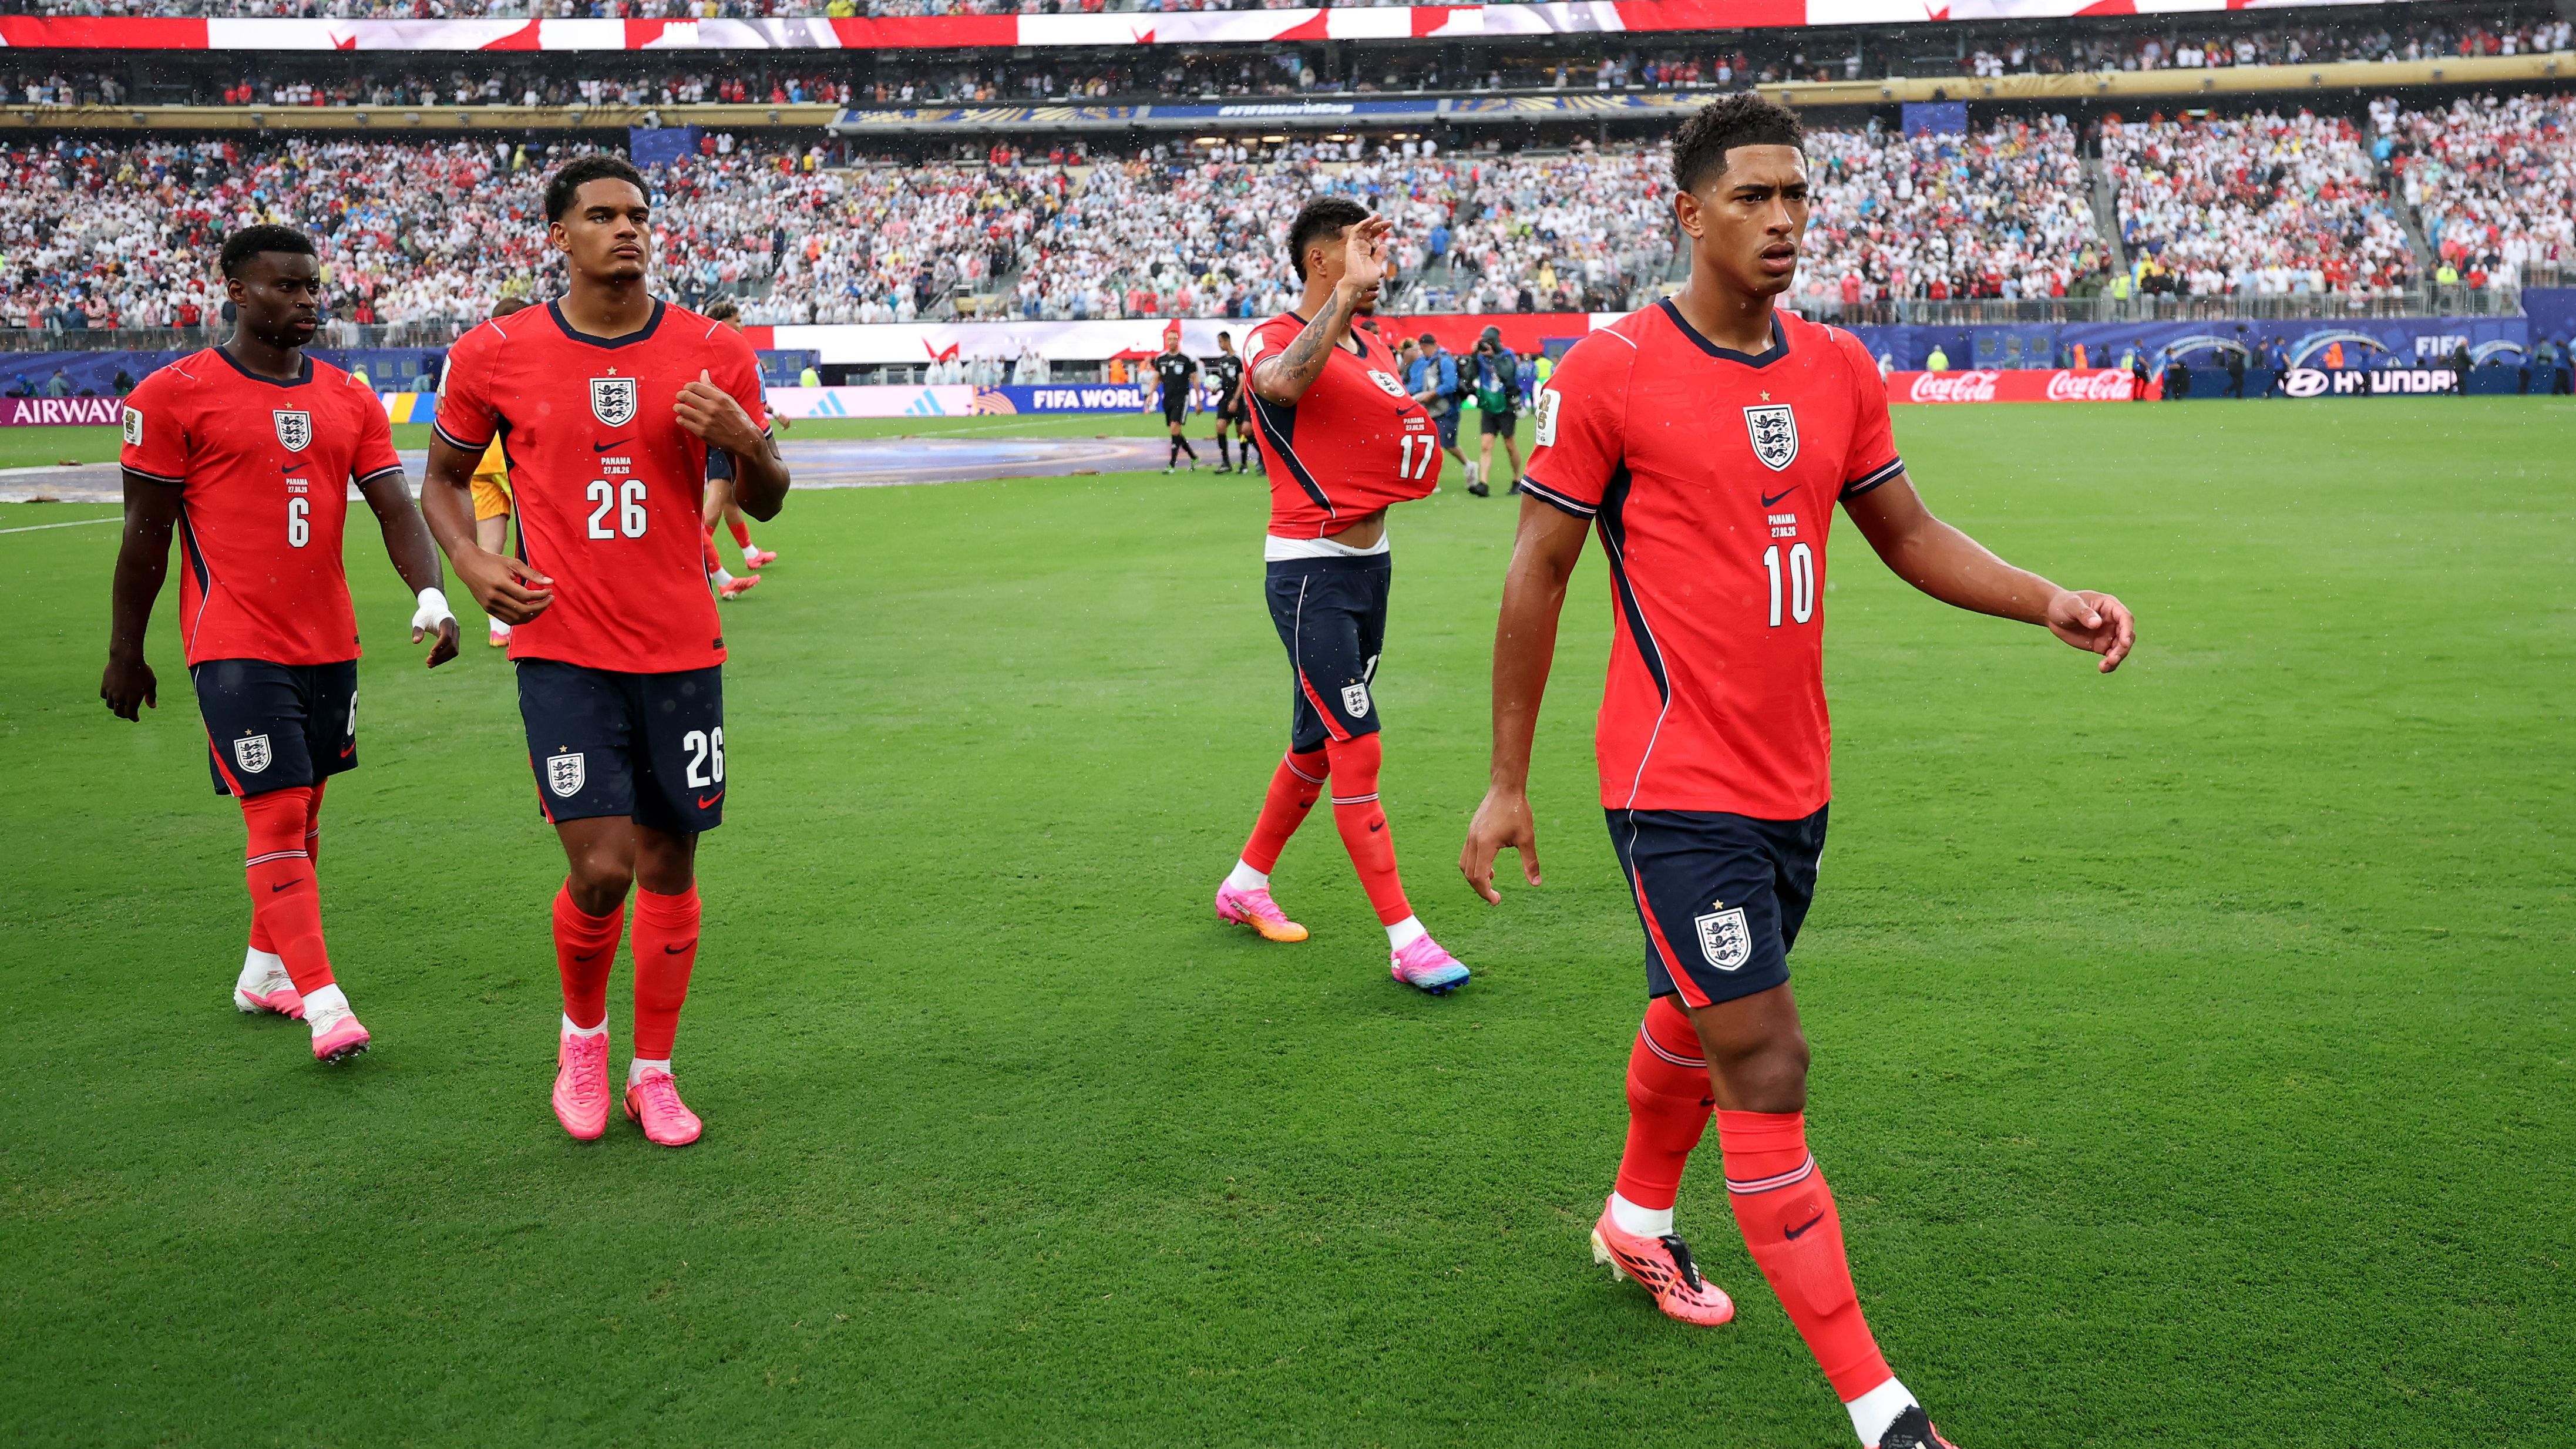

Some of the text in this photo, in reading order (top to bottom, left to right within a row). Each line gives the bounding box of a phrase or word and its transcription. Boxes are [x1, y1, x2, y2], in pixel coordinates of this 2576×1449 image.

[12, 398, 125, 424] AIRWAY
[1034, 389, 1080, 408] FIFA
[601, 457, 631, 465] PANAMA
[603, 466, 630, 475] 27.06.26
[1400, 434, 1435, 480] 17
[288, 497, 310, 547] 6
[587, 479, 648, 540] 26
[1768, 513, 1796, 526] PANAMA
[1771, 526, 1797, 538] 27.06.26
[1763, 542, 1814, 627] 10
[347, 690, 358, 736] 6
[683, 726, 724, 788] 26
